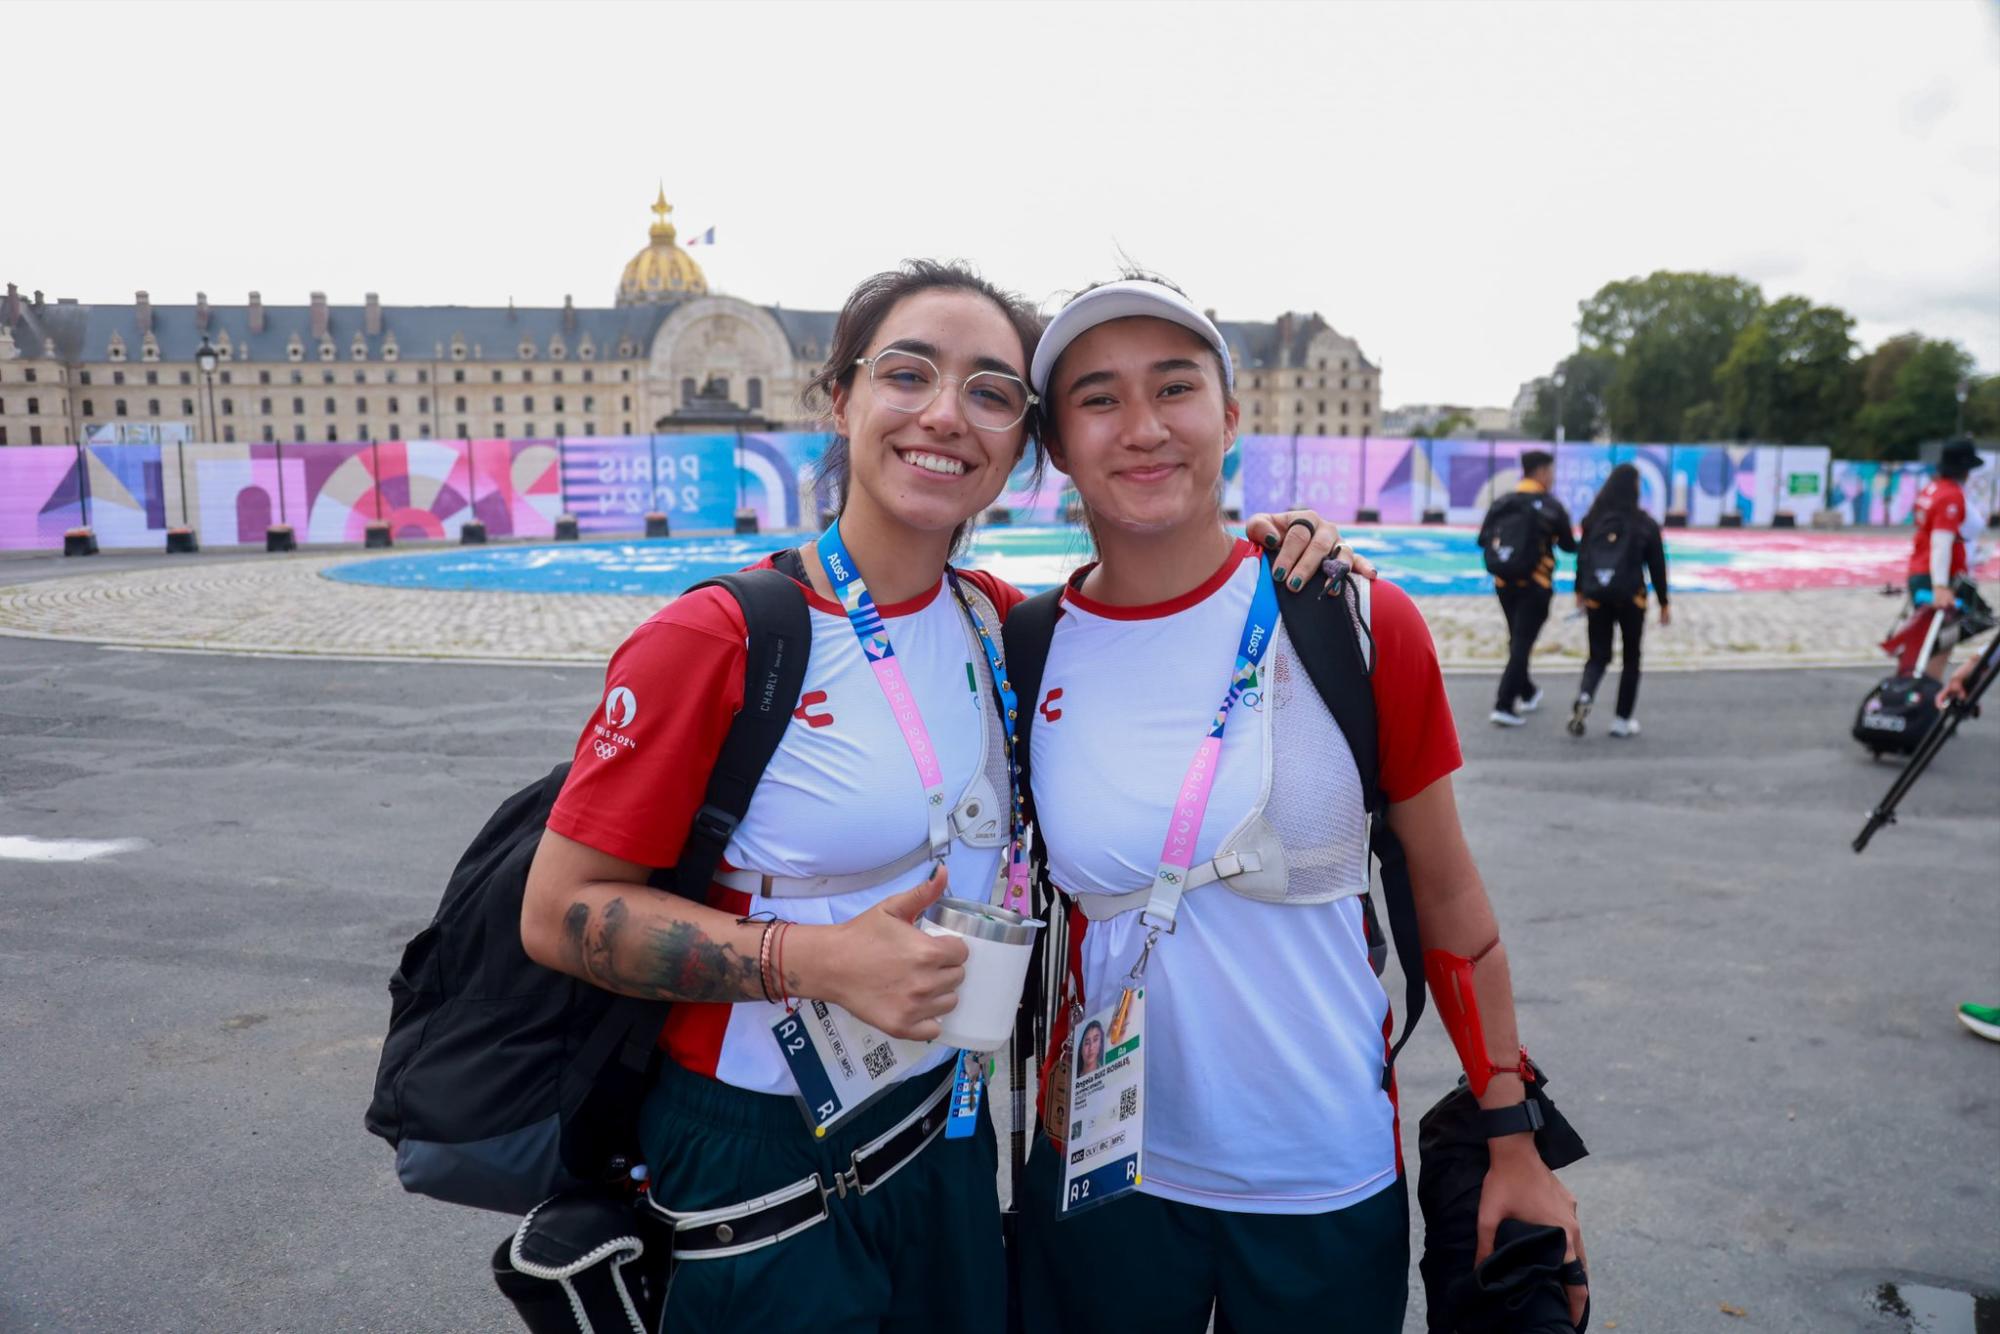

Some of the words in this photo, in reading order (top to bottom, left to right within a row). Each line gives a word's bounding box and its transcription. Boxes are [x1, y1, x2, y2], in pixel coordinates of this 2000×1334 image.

[760, 671, 778, 712] CHARLY
[882, 668, 914, 721] PARIS
[908, 726, 935, 778] 2024
[612, 732, 636, 748] 2024
[1184, 747, 1210, 801] PARIS
[817, 1100, 835, 1120] R
[1126, 1160, 1136, 1181] R
